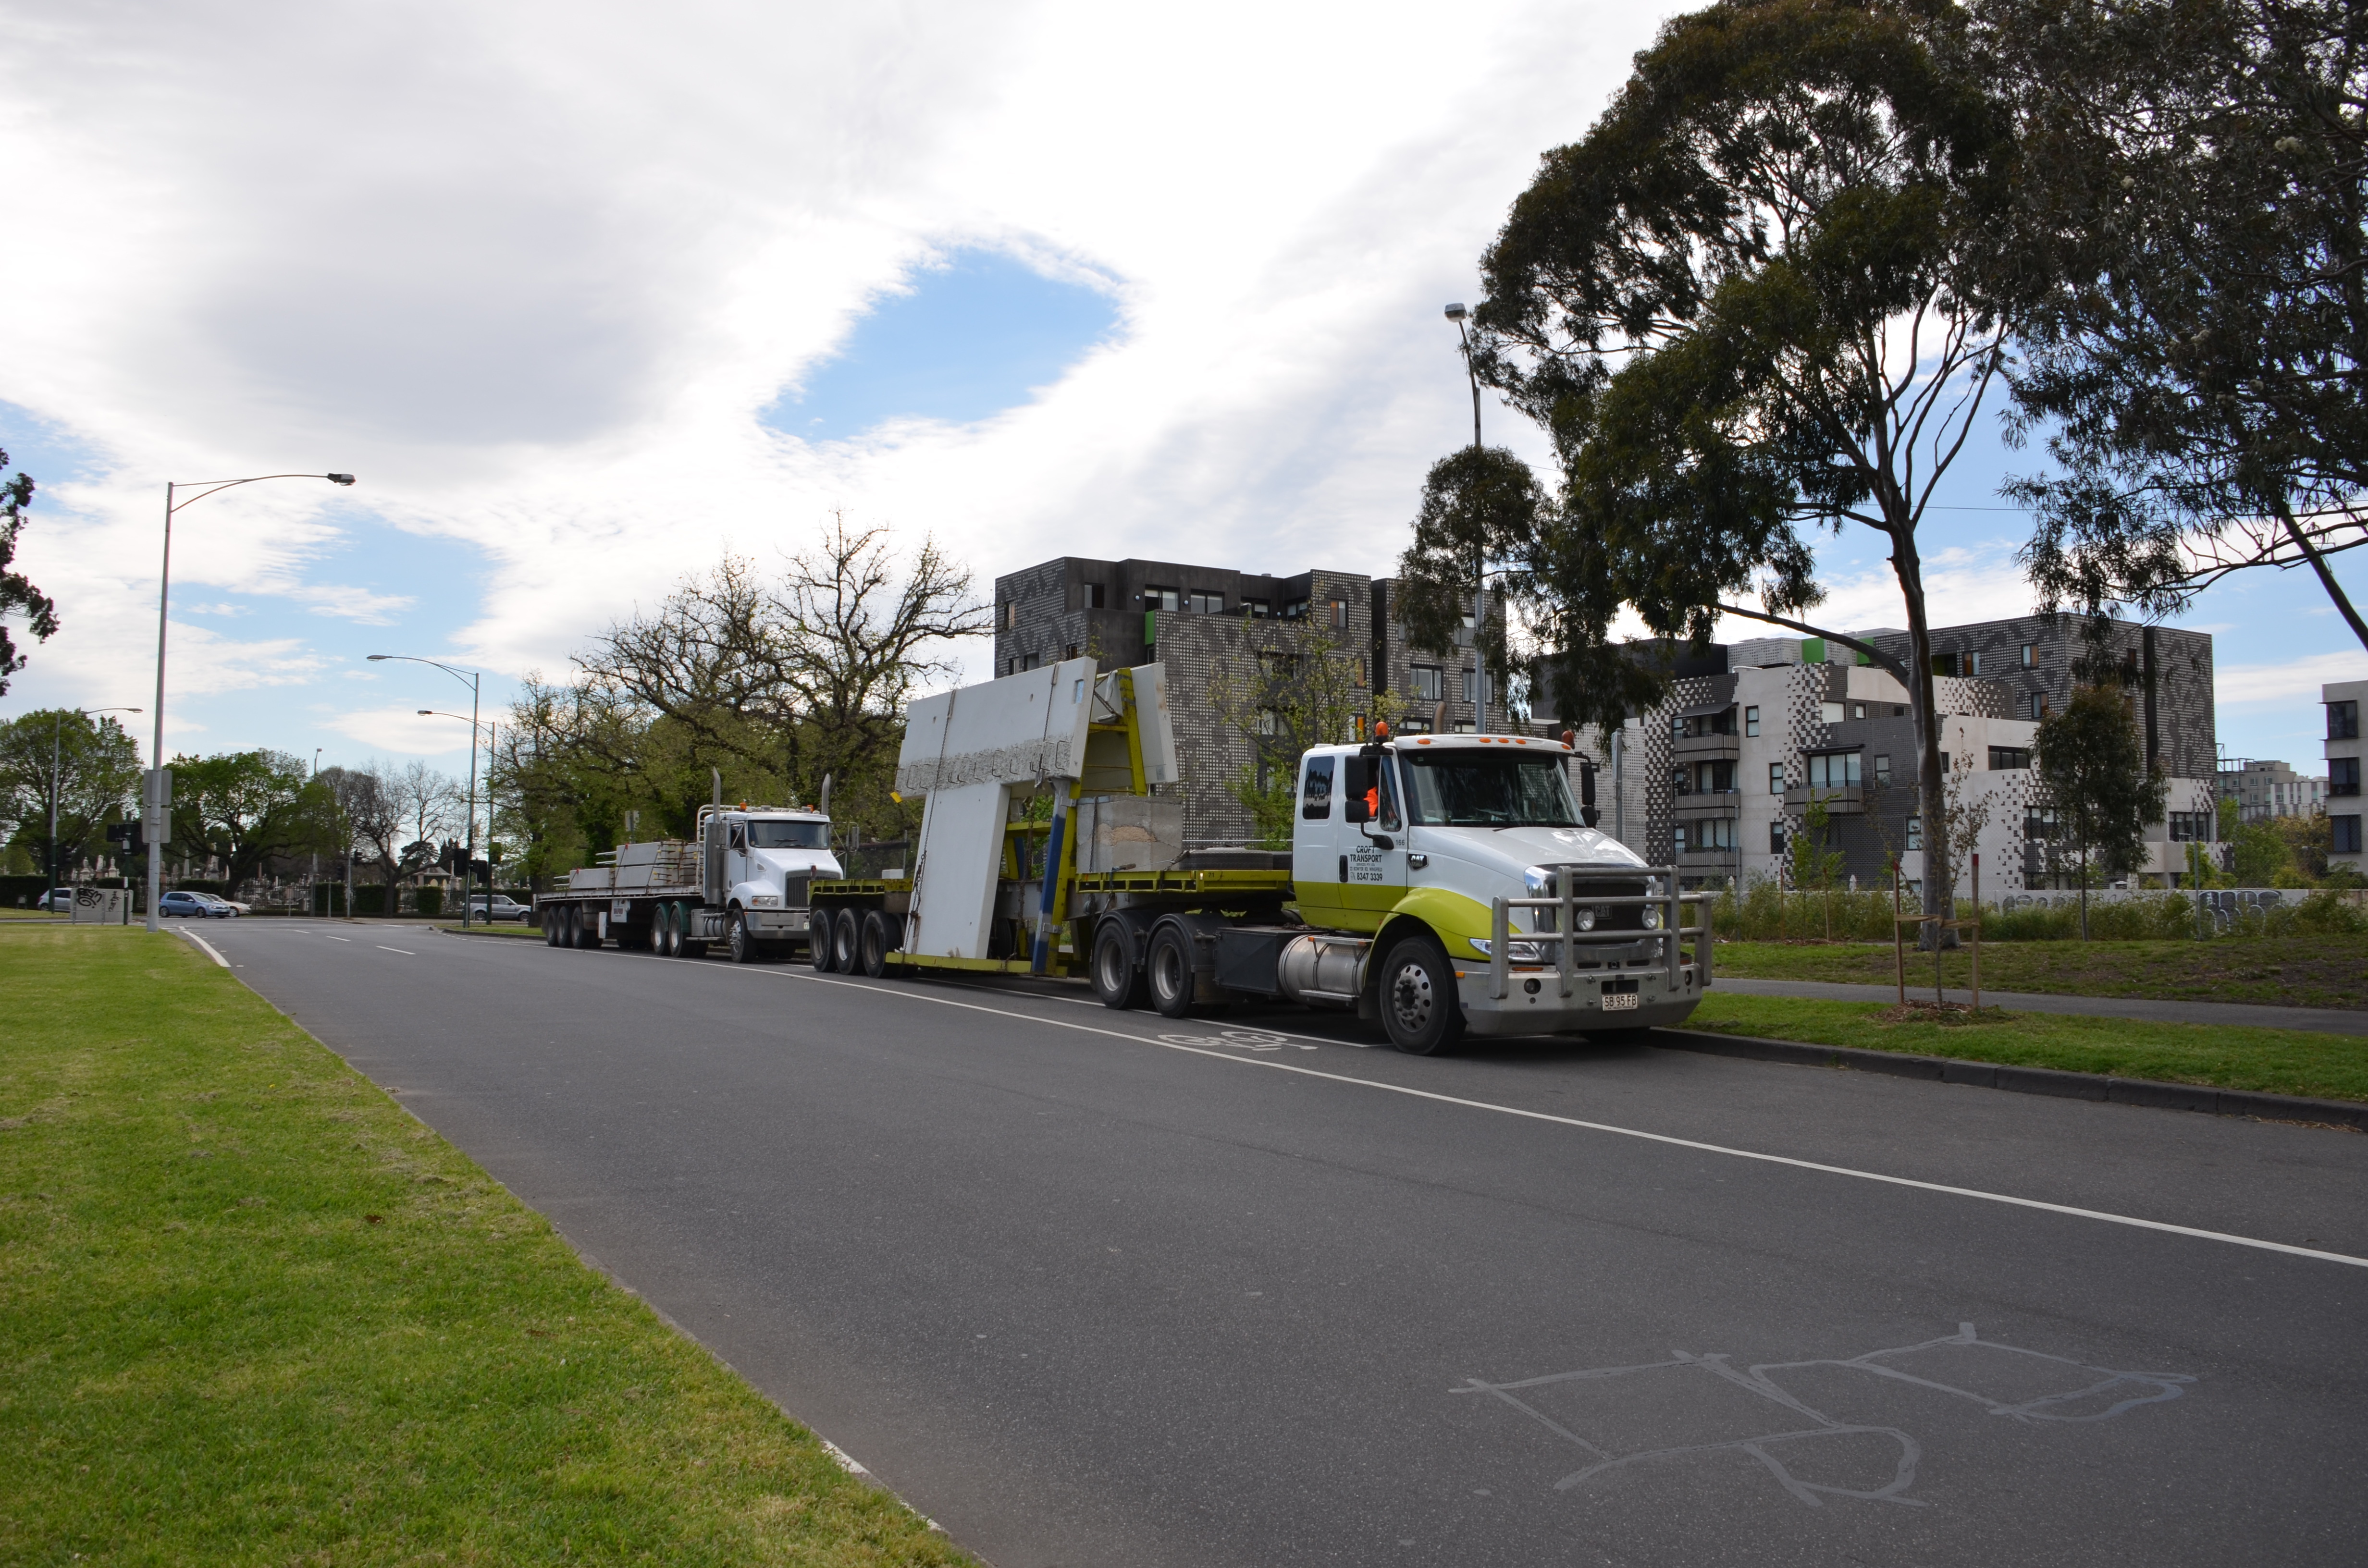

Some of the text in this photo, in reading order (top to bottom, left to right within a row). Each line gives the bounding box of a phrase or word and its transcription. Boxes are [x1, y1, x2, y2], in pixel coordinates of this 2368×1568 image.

[1356, 845, 1375, 854] CROFT
[1350, 854, 1382, 862] TRANSPORT
[1411, 855, 1424, 867] CAT
[1370, 873, 1383, 881] 3339
[1595, 906, 1610, 918] CAT
[1605, 995, 1636, 1006] SB 95 FB
